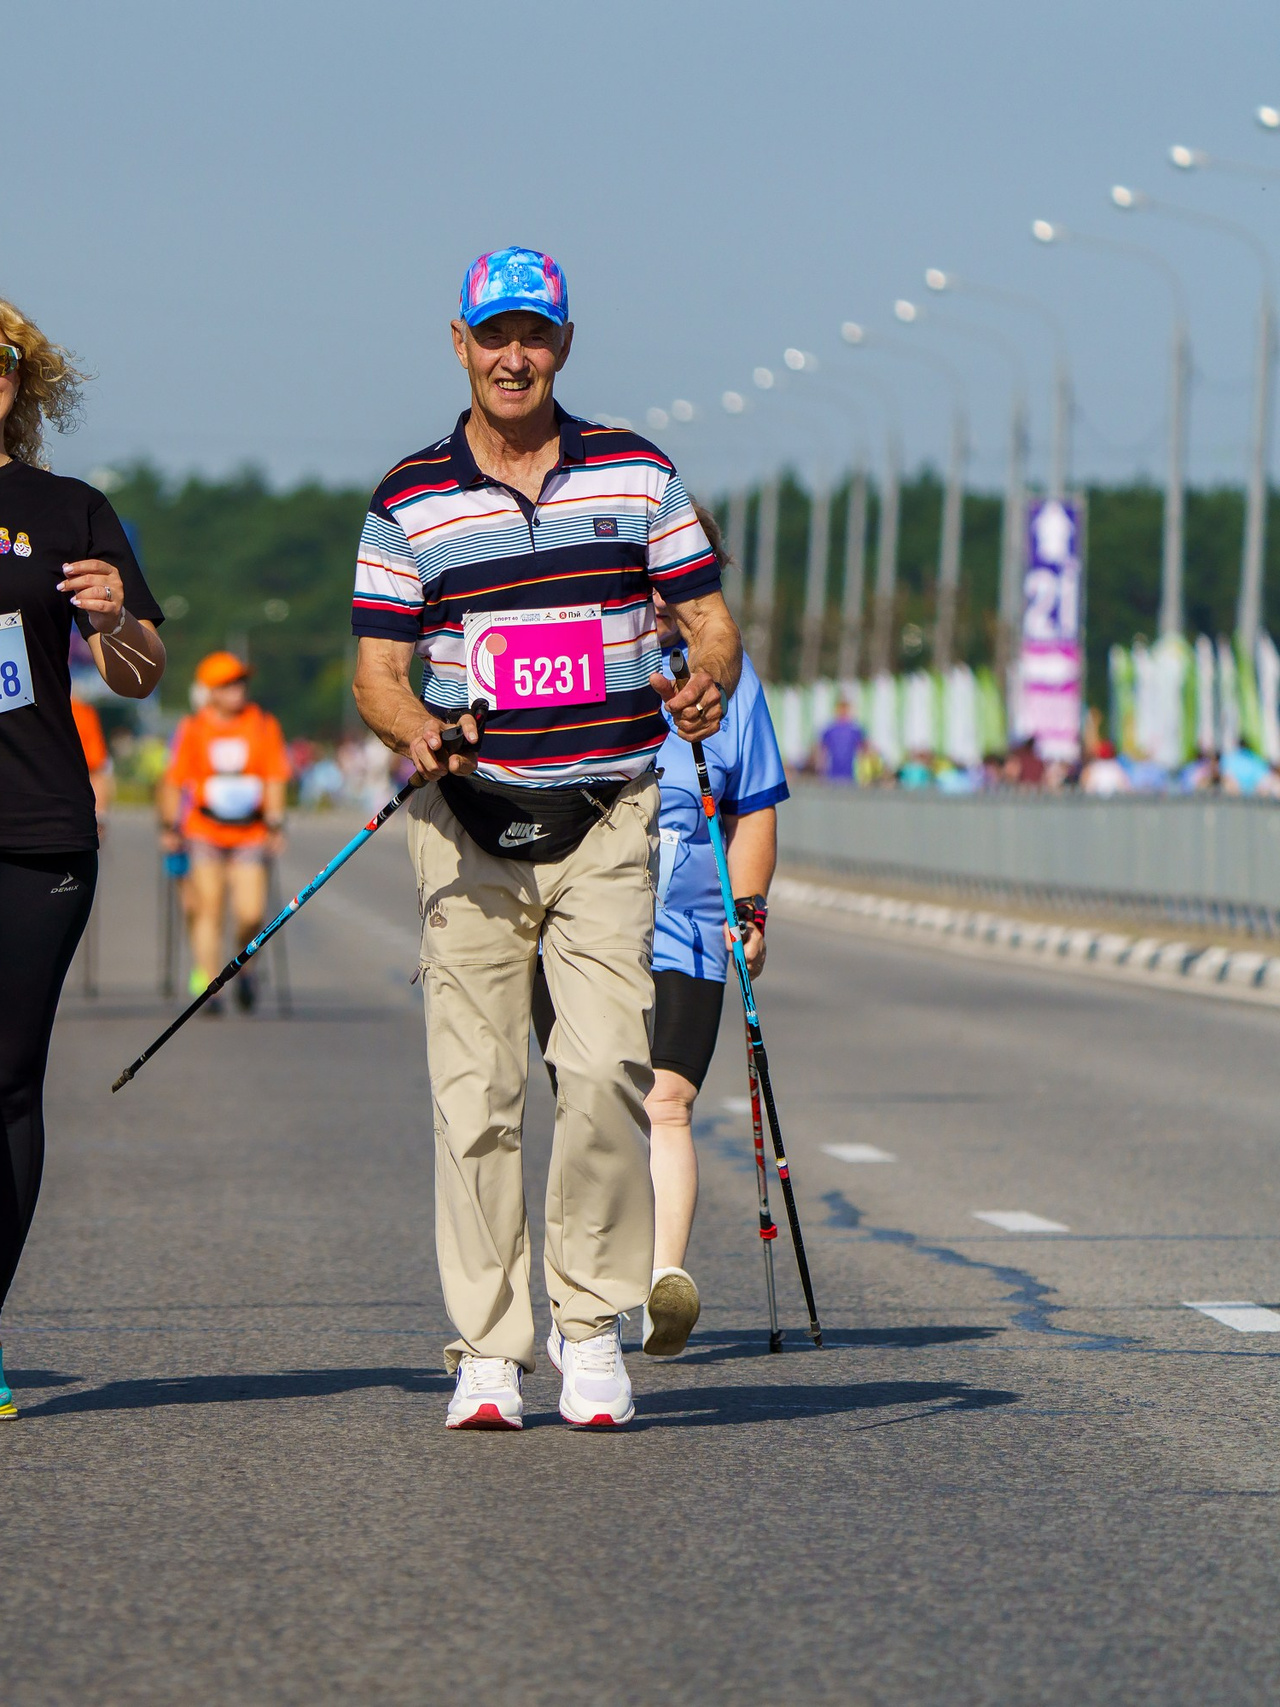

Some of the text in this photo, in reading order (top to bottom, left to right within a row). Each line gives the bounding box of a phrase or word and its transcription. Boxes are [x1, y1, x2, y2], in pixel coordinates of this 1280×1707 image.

[513, 653, 591, 697] 5231
[506, 821, 542, 838] NIKE
[50, 885, 79, 894] DEMIX
